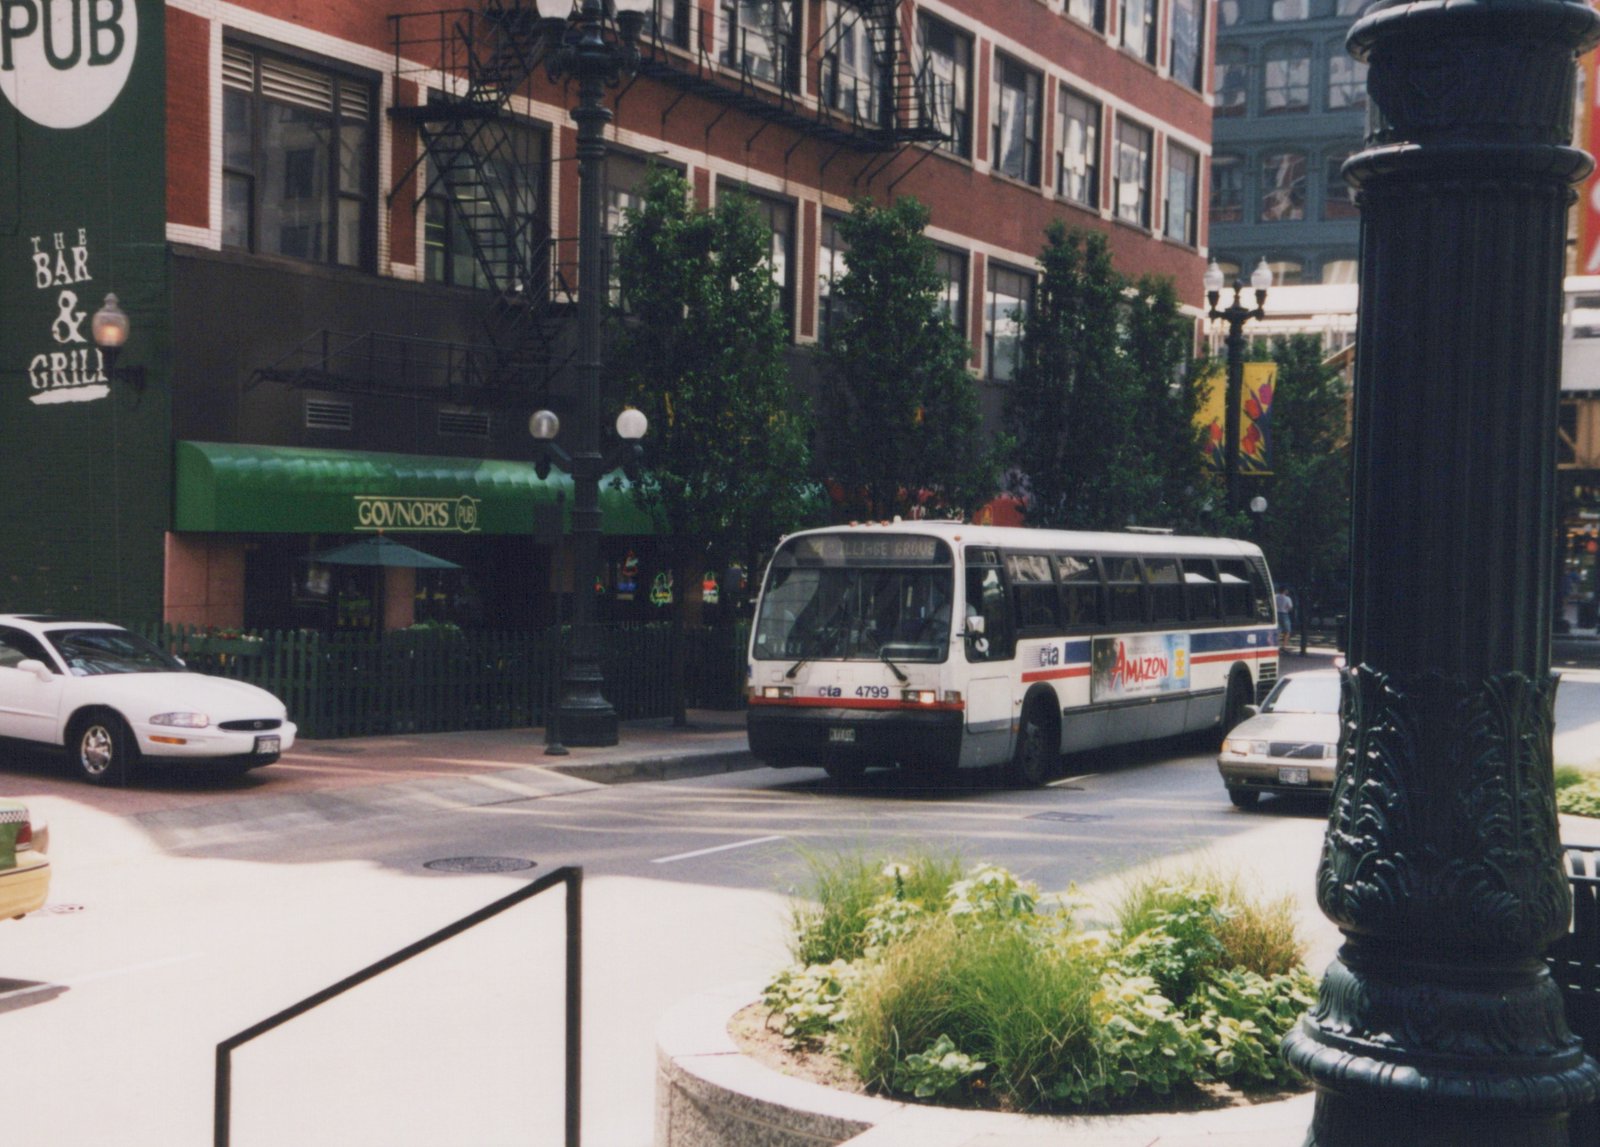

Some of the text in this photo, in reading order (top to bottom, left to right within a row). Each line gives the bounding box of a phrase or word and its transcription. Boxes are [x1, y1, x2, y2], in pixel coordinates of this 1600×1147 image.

[1, 0, 124, 71] PUB
[31, 228, 87, 253] THE
[33, 246, 92, 289] BAR
[52, 290, 87, 343] &
[29, 348, 109, 389] GRILL
[359, 501, 474, 526] GOVNOR'S PUB
[1040, 643, 1059, 667] cta
[818, 685, 889, 698] cta 4799
